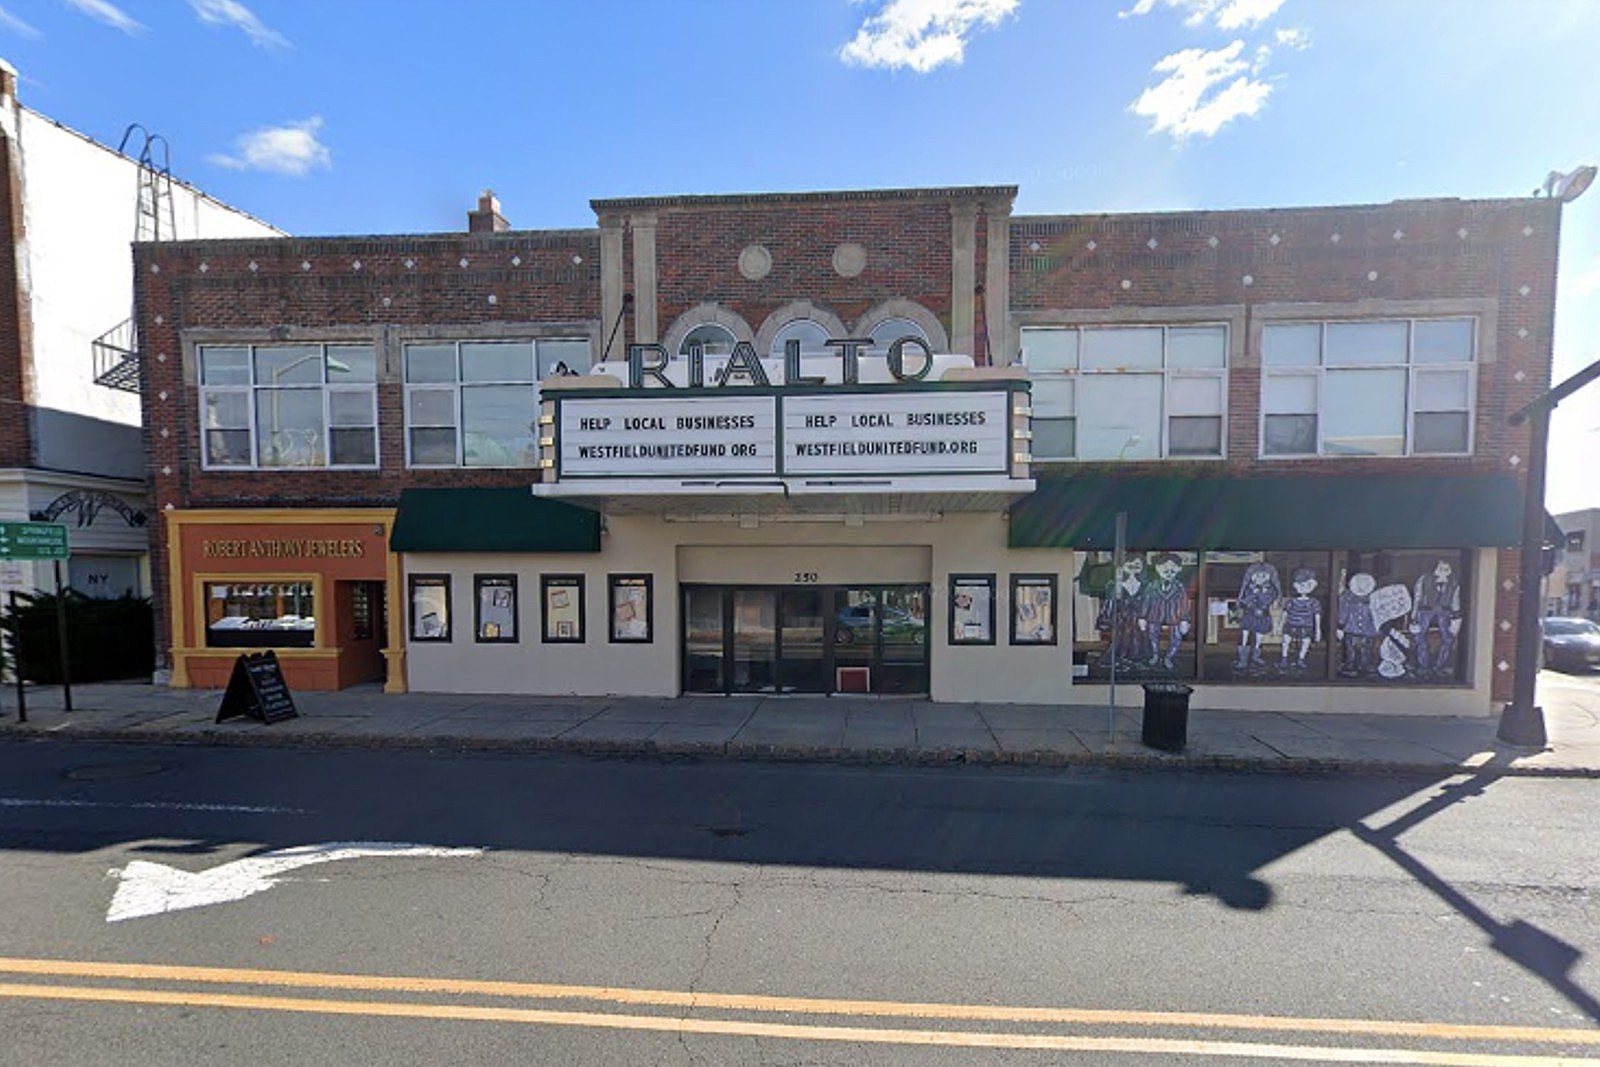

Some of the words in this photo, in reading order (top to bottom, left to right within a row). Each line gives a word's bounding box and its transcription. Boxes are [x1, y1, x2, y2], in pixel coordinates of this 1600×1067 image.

[628, 335, 934, 389] RIALTO
[580, 417, 612, 430] HELP
[624, 417, 666, 430] LOCAL
[676, 415, 755, 430] BUSINESSES
[805, 414, 837, 428] HELP
[851, 413, 894, 428] LOCAL
[906, 411, 986, 426] BUSINESSES
[795, 440, 978, 457] WESTFIELDUNITEDFUND.ORG
[202, 539, 247, 558] ROBERT
[250, 539, 305, 558] ANTHONY
[306, 539, 364, 558] JEWELERS
[794, 572, 818, 583] 250
